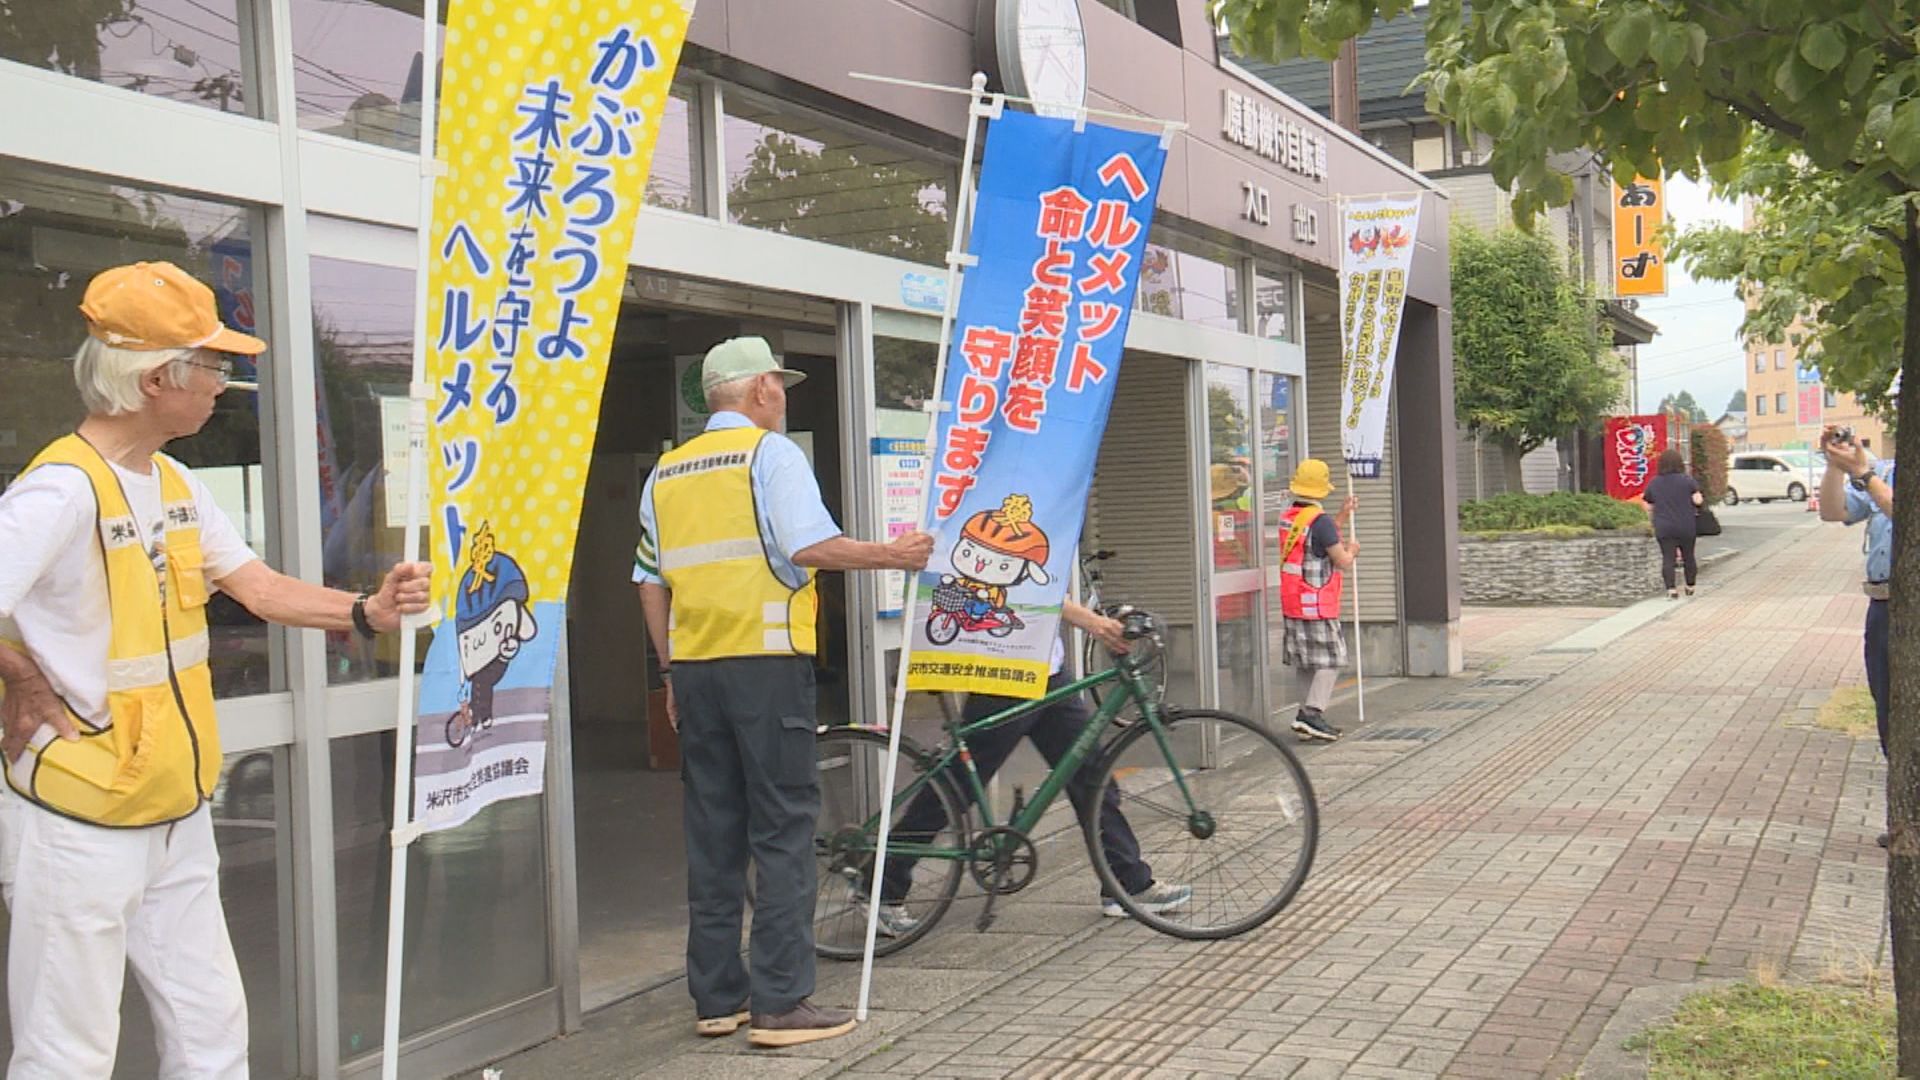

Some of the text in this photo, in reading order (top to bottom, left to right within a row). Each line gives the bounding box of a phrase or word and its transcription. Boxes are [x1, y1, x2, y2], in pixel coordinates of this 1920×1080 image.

[485, 80, 571, 425] 未来を守る
[538, 28, 656, 360] かぶろうよ
[1001, 186, 1092, 434] 命と笑顔を
[1065, 151, 1149, 392] ヘルメット
[1242, 181, 1270, 225] 入口
[436, 224, 489, 569] ヘルメット
[935, 325, 1016, 519] 守ります
[907, 661, 1038, 685] 沢市交通安全推進協議会
